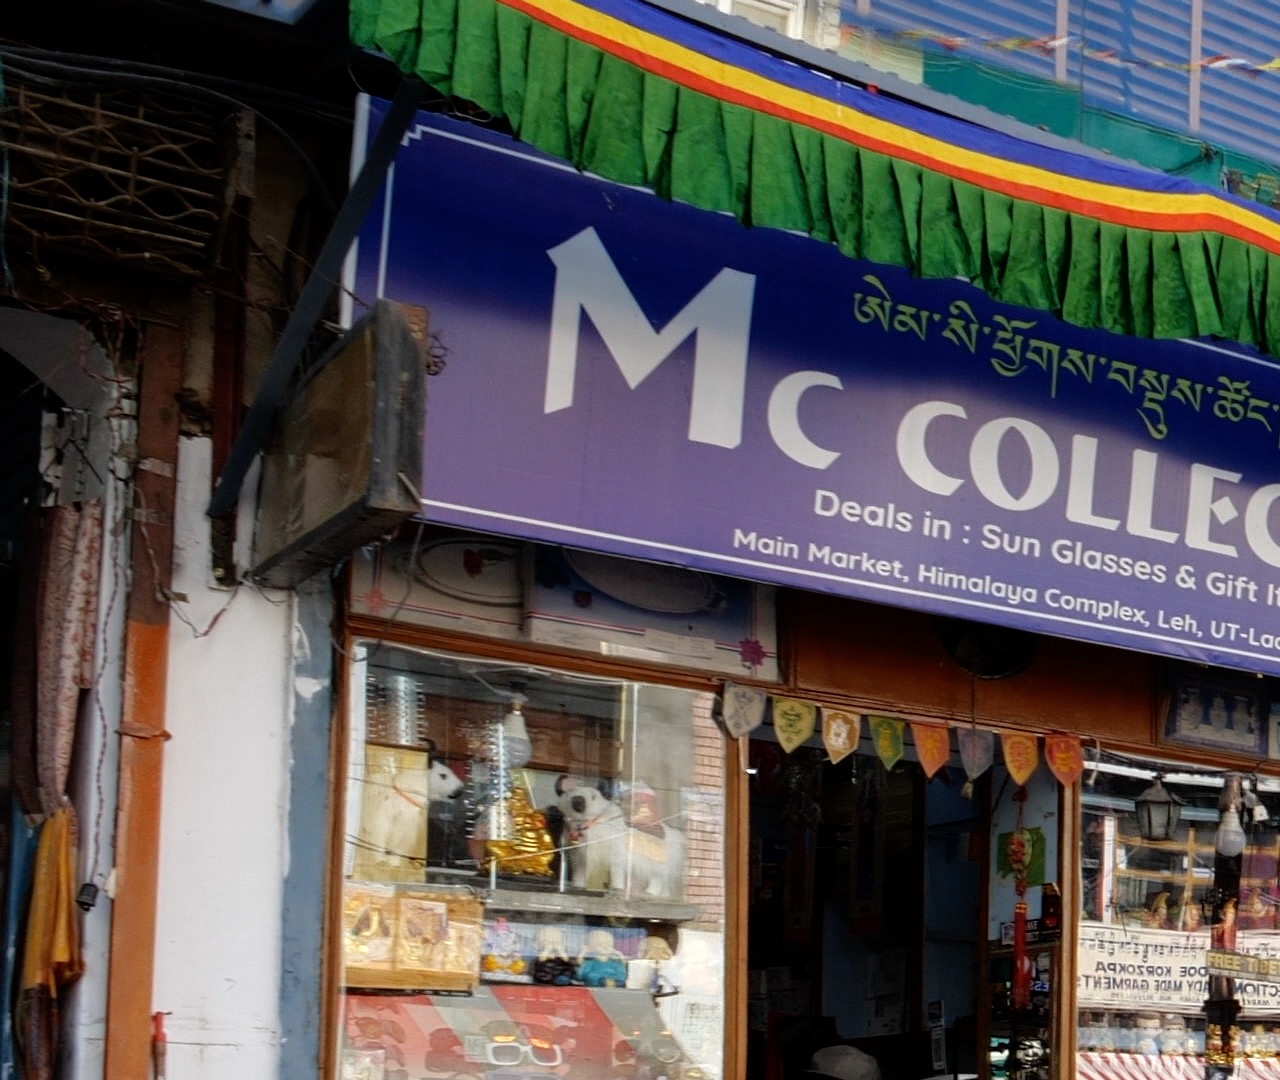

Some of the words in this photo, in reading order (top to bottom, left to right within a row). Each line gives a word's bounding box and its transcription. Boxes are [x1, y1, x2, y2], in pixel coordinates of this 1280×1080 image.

[732, 528, 801, 560] Main
[808, 545, 911, 586] Market,
[918, 564, 1038, 606] Himalaya
[1044, 587, 1151, 629] Complex,
[1157, 610, 1205, 639] Leh,
[813, 488, 914, 535] Deals
[922, 510, 952, 541] in
[981, 524, 1042, 558] Sun
[1052, 538, 1168, 585] Glasses
[1175, 565, 1198, 590] &
[1206, 573, 1258, 605] Gift
[1206, 951, 1243, 972] FREE
